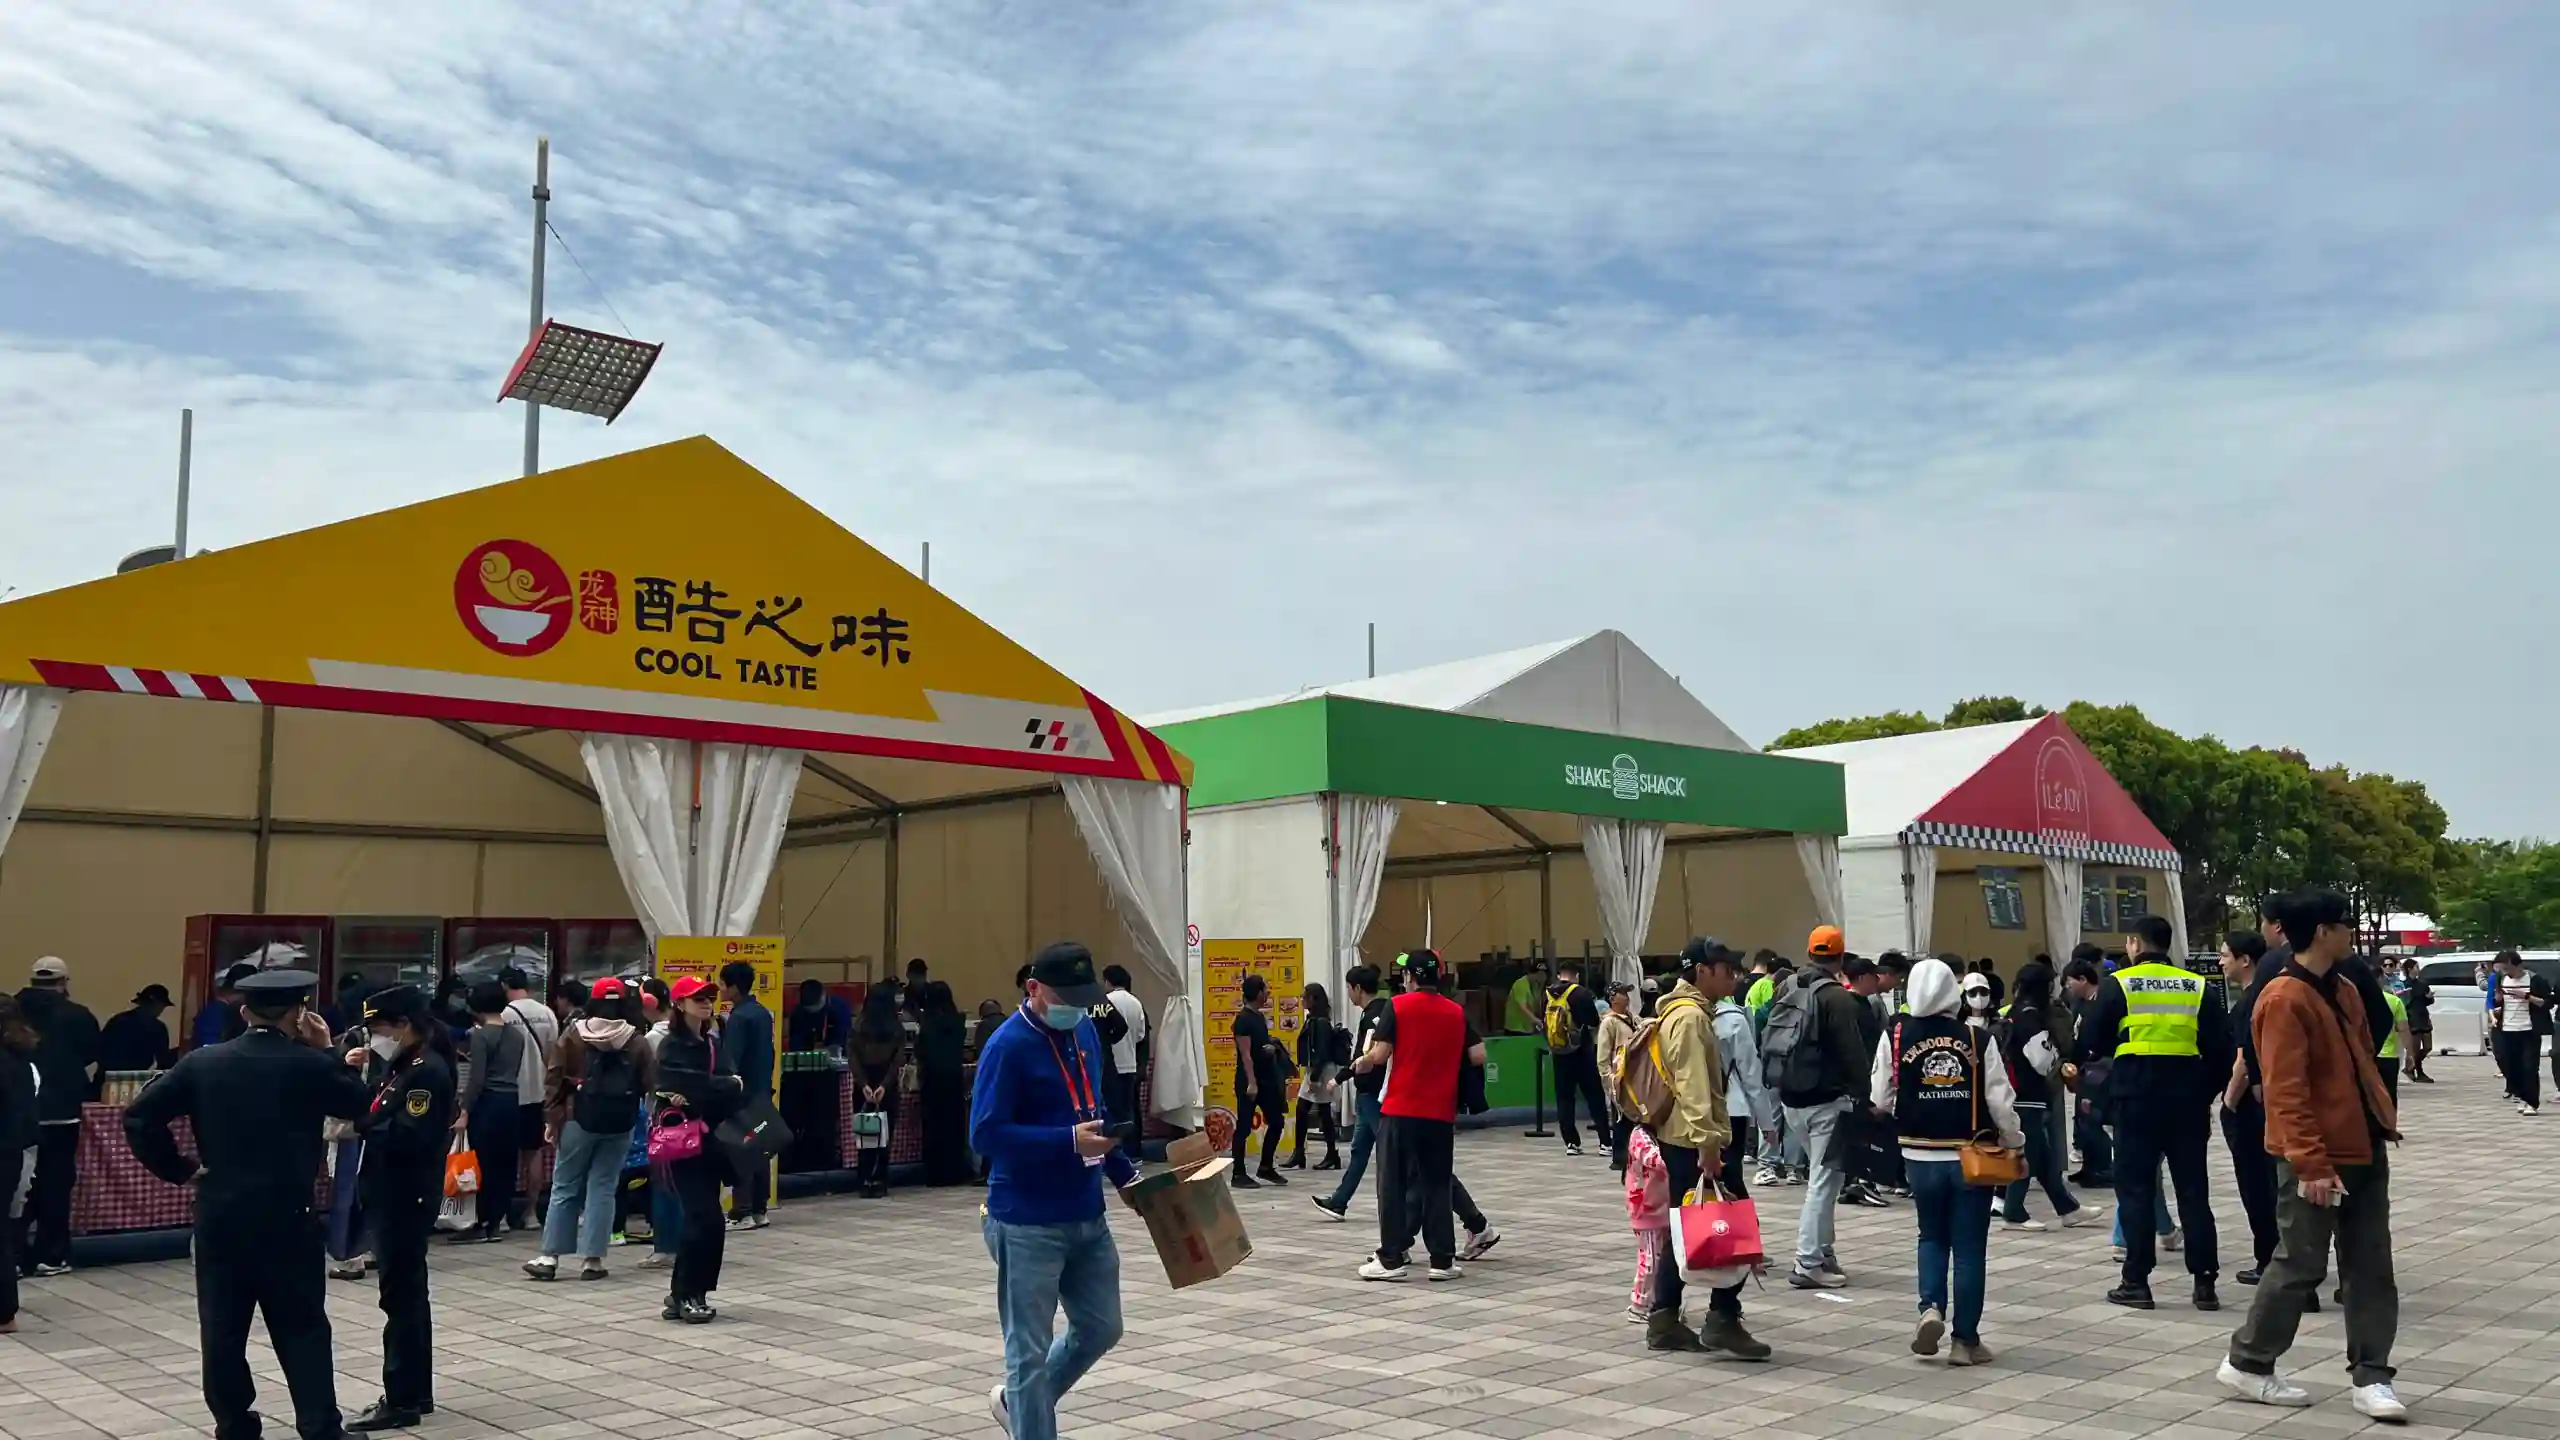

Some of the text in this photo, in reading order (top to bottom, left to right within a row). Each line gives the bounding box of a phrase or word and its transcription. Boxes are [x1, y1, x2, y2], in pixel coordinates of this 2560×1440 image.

[579, 571, 618, 631] 龙神
[634, 577, 911, 668] 酷之味
[635, 647, 818, 690] COOL TASTE
[1565, 764, 1686, 797] SHAKE SHACK
[2146, 979, 2180, 990] POLICE
[1918, 1090, 1971, 1099] KATHERINE
